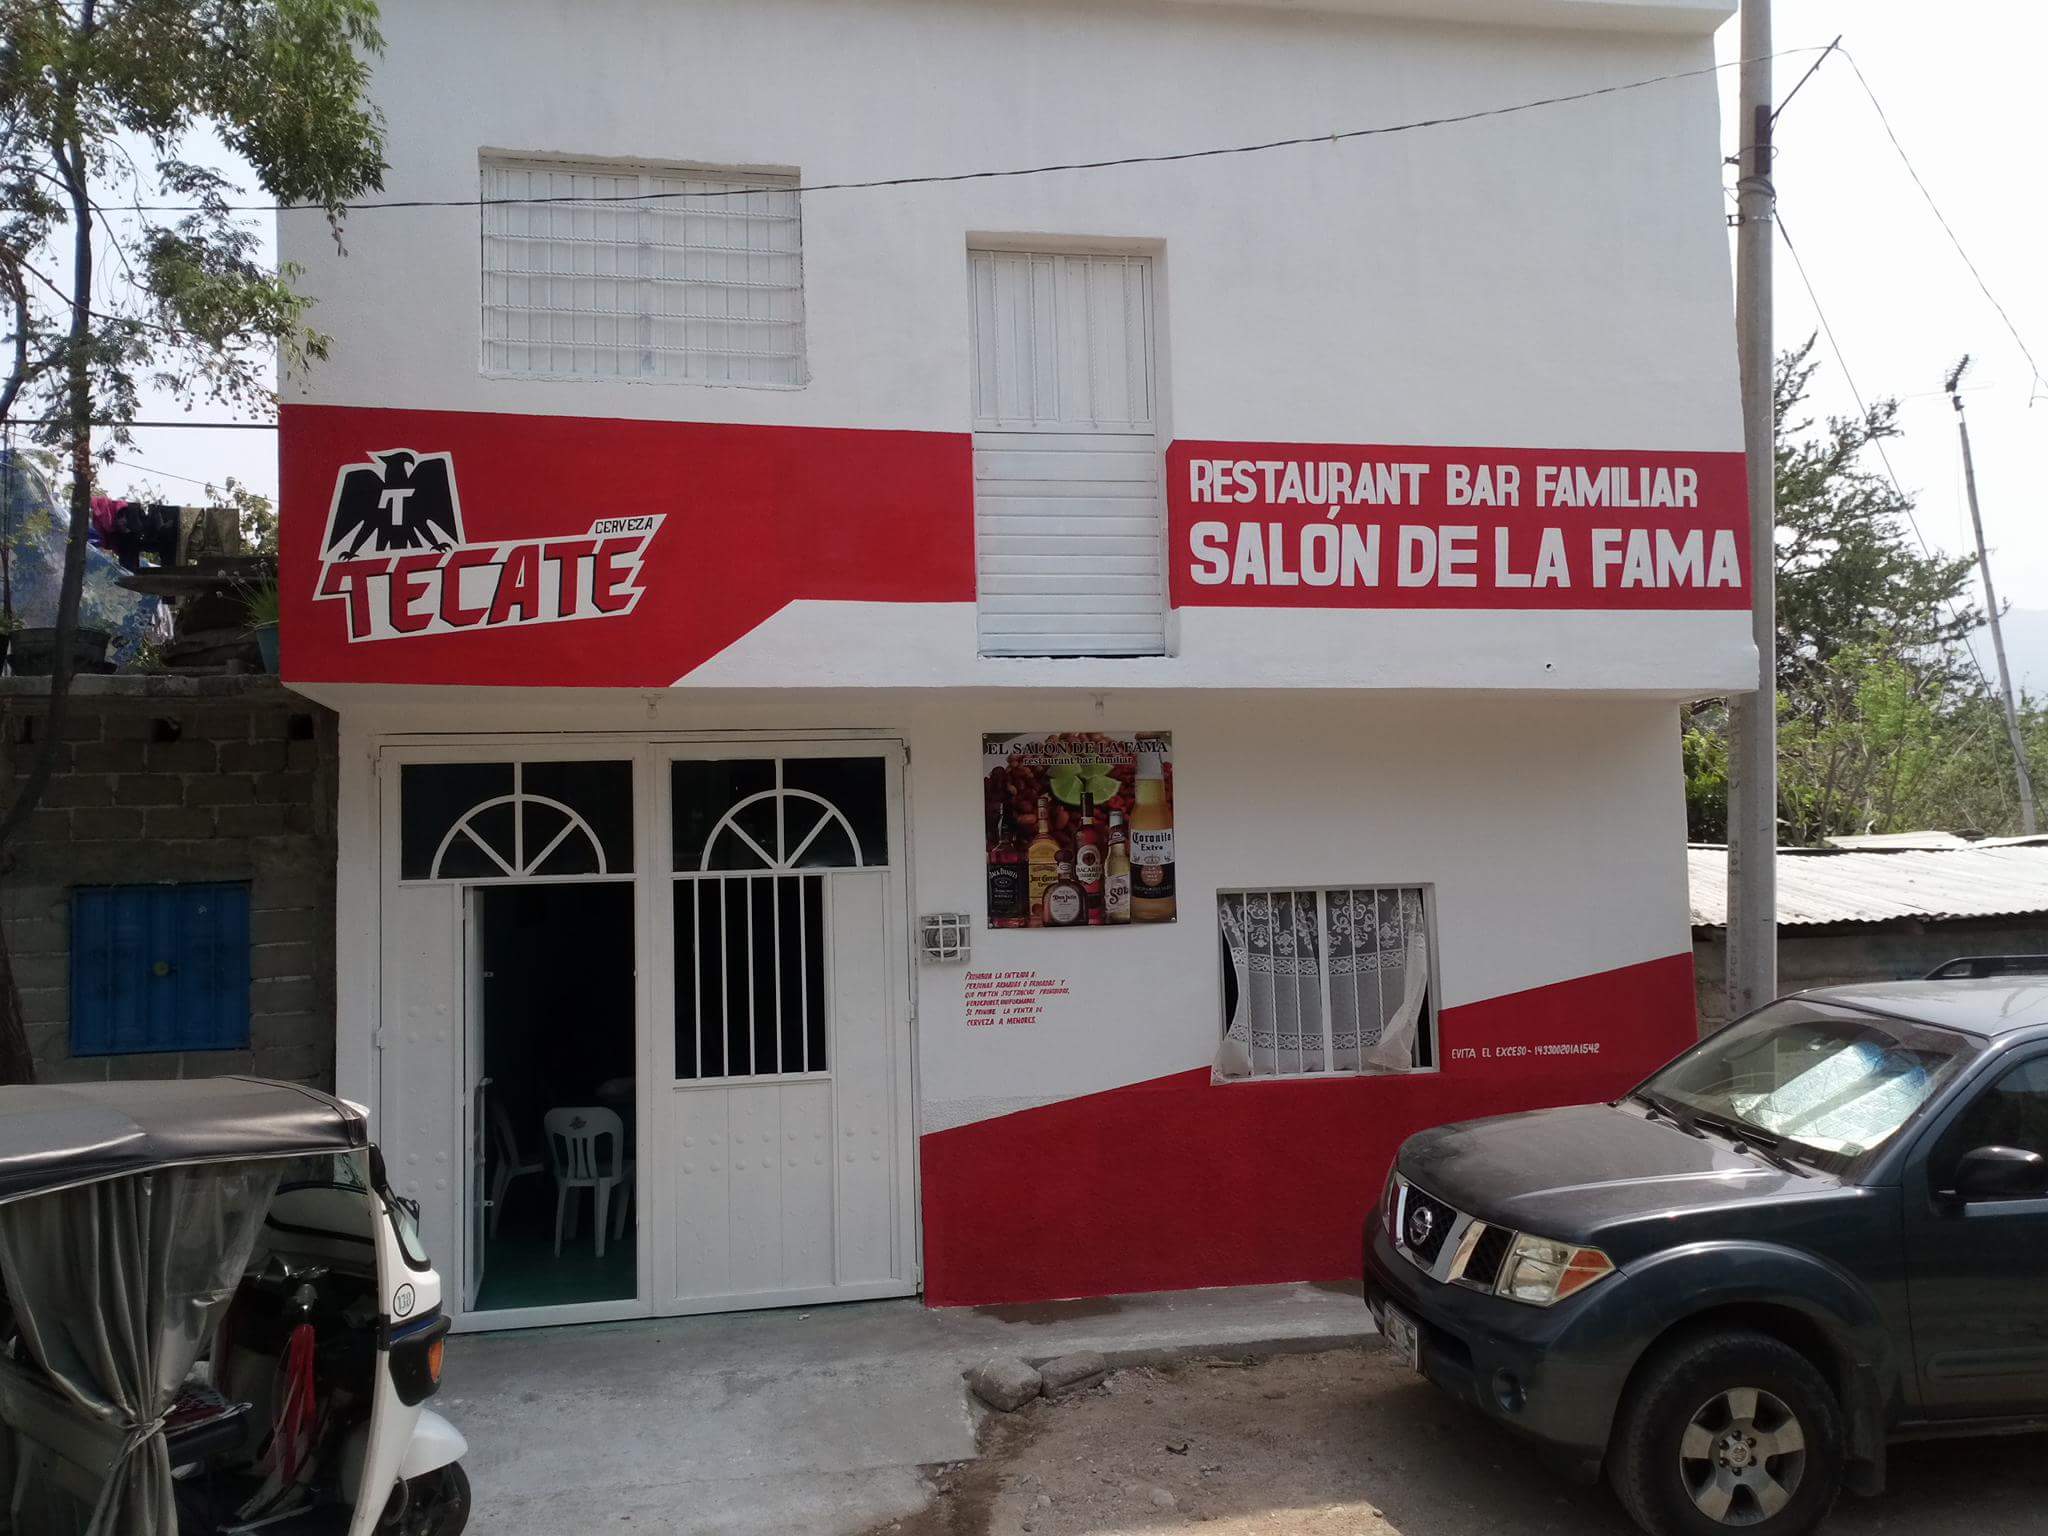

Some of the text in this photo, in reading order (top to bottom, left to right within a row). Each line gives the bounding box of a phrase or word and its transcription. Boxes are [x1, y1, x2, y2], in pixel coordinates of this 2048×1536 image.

[1190, 460, 1698, 507] RESTAURANT BAR FAMILIAR
[594, 516, 653, 535] CERVEZA
[1189, 507, 1742, 588] SALÓN DE LA FAMA
[318, 536, 652, 639] TECATE
[987, 743, 1008, 754] EL
[1073, 742, 1098, 754] DE
[1100, 742, 1121, 753] LA
[1124, 741, 1168, 753] FAMA
[1024, 755, 1132, 765] restaurant bar familiar
[1132, 832, 1172, 845] Coronita
[1013, 1006, 1033, 1014] VENTA
[967, 1018, 995, 1026] CERVEZA
[1452, 1048, 1477, 1059] EVITA
[1482, 1047, 1492, 1058] EL
